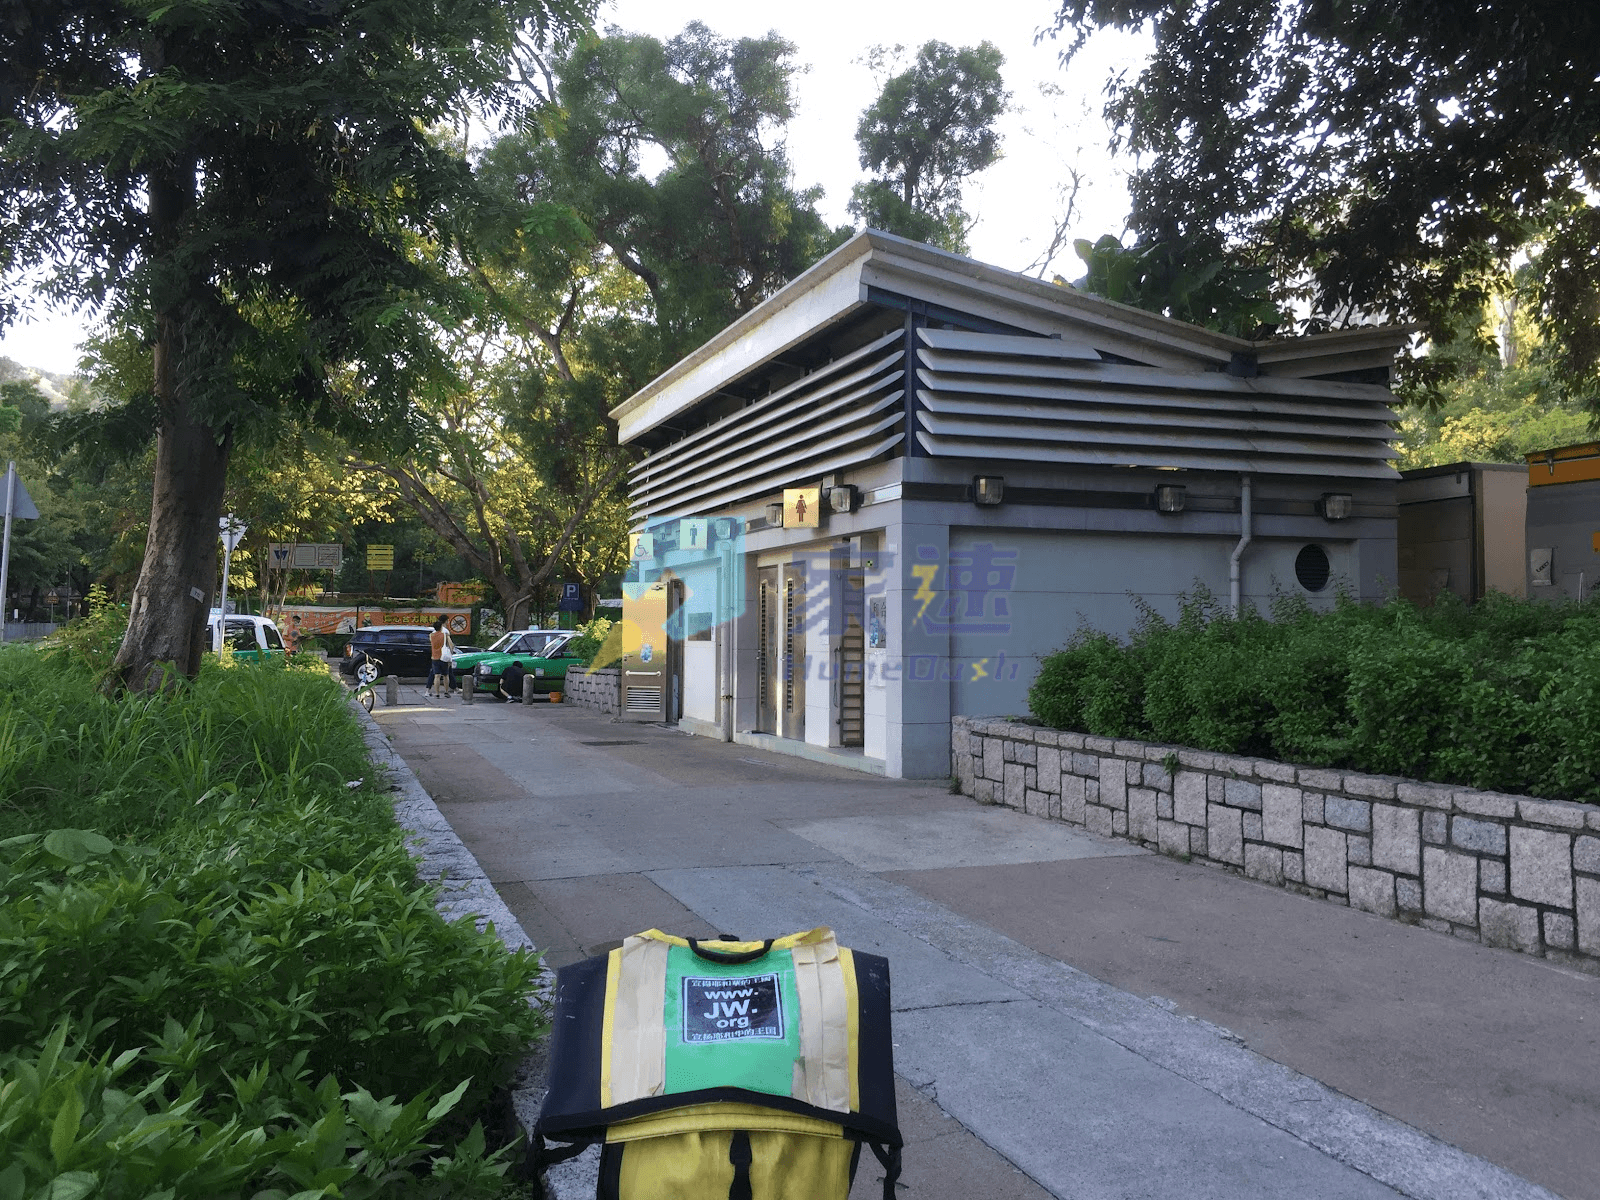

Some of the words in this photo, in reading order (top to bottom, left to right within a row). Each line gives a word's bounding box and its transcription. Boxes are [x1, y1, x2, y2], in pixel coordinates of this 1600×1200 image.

[567, 585, 577, 597] P
[704, 988, 758, 999] www.
[703, 999, 758, 1019] JW.
[716, 1016, 749, 1028] org
